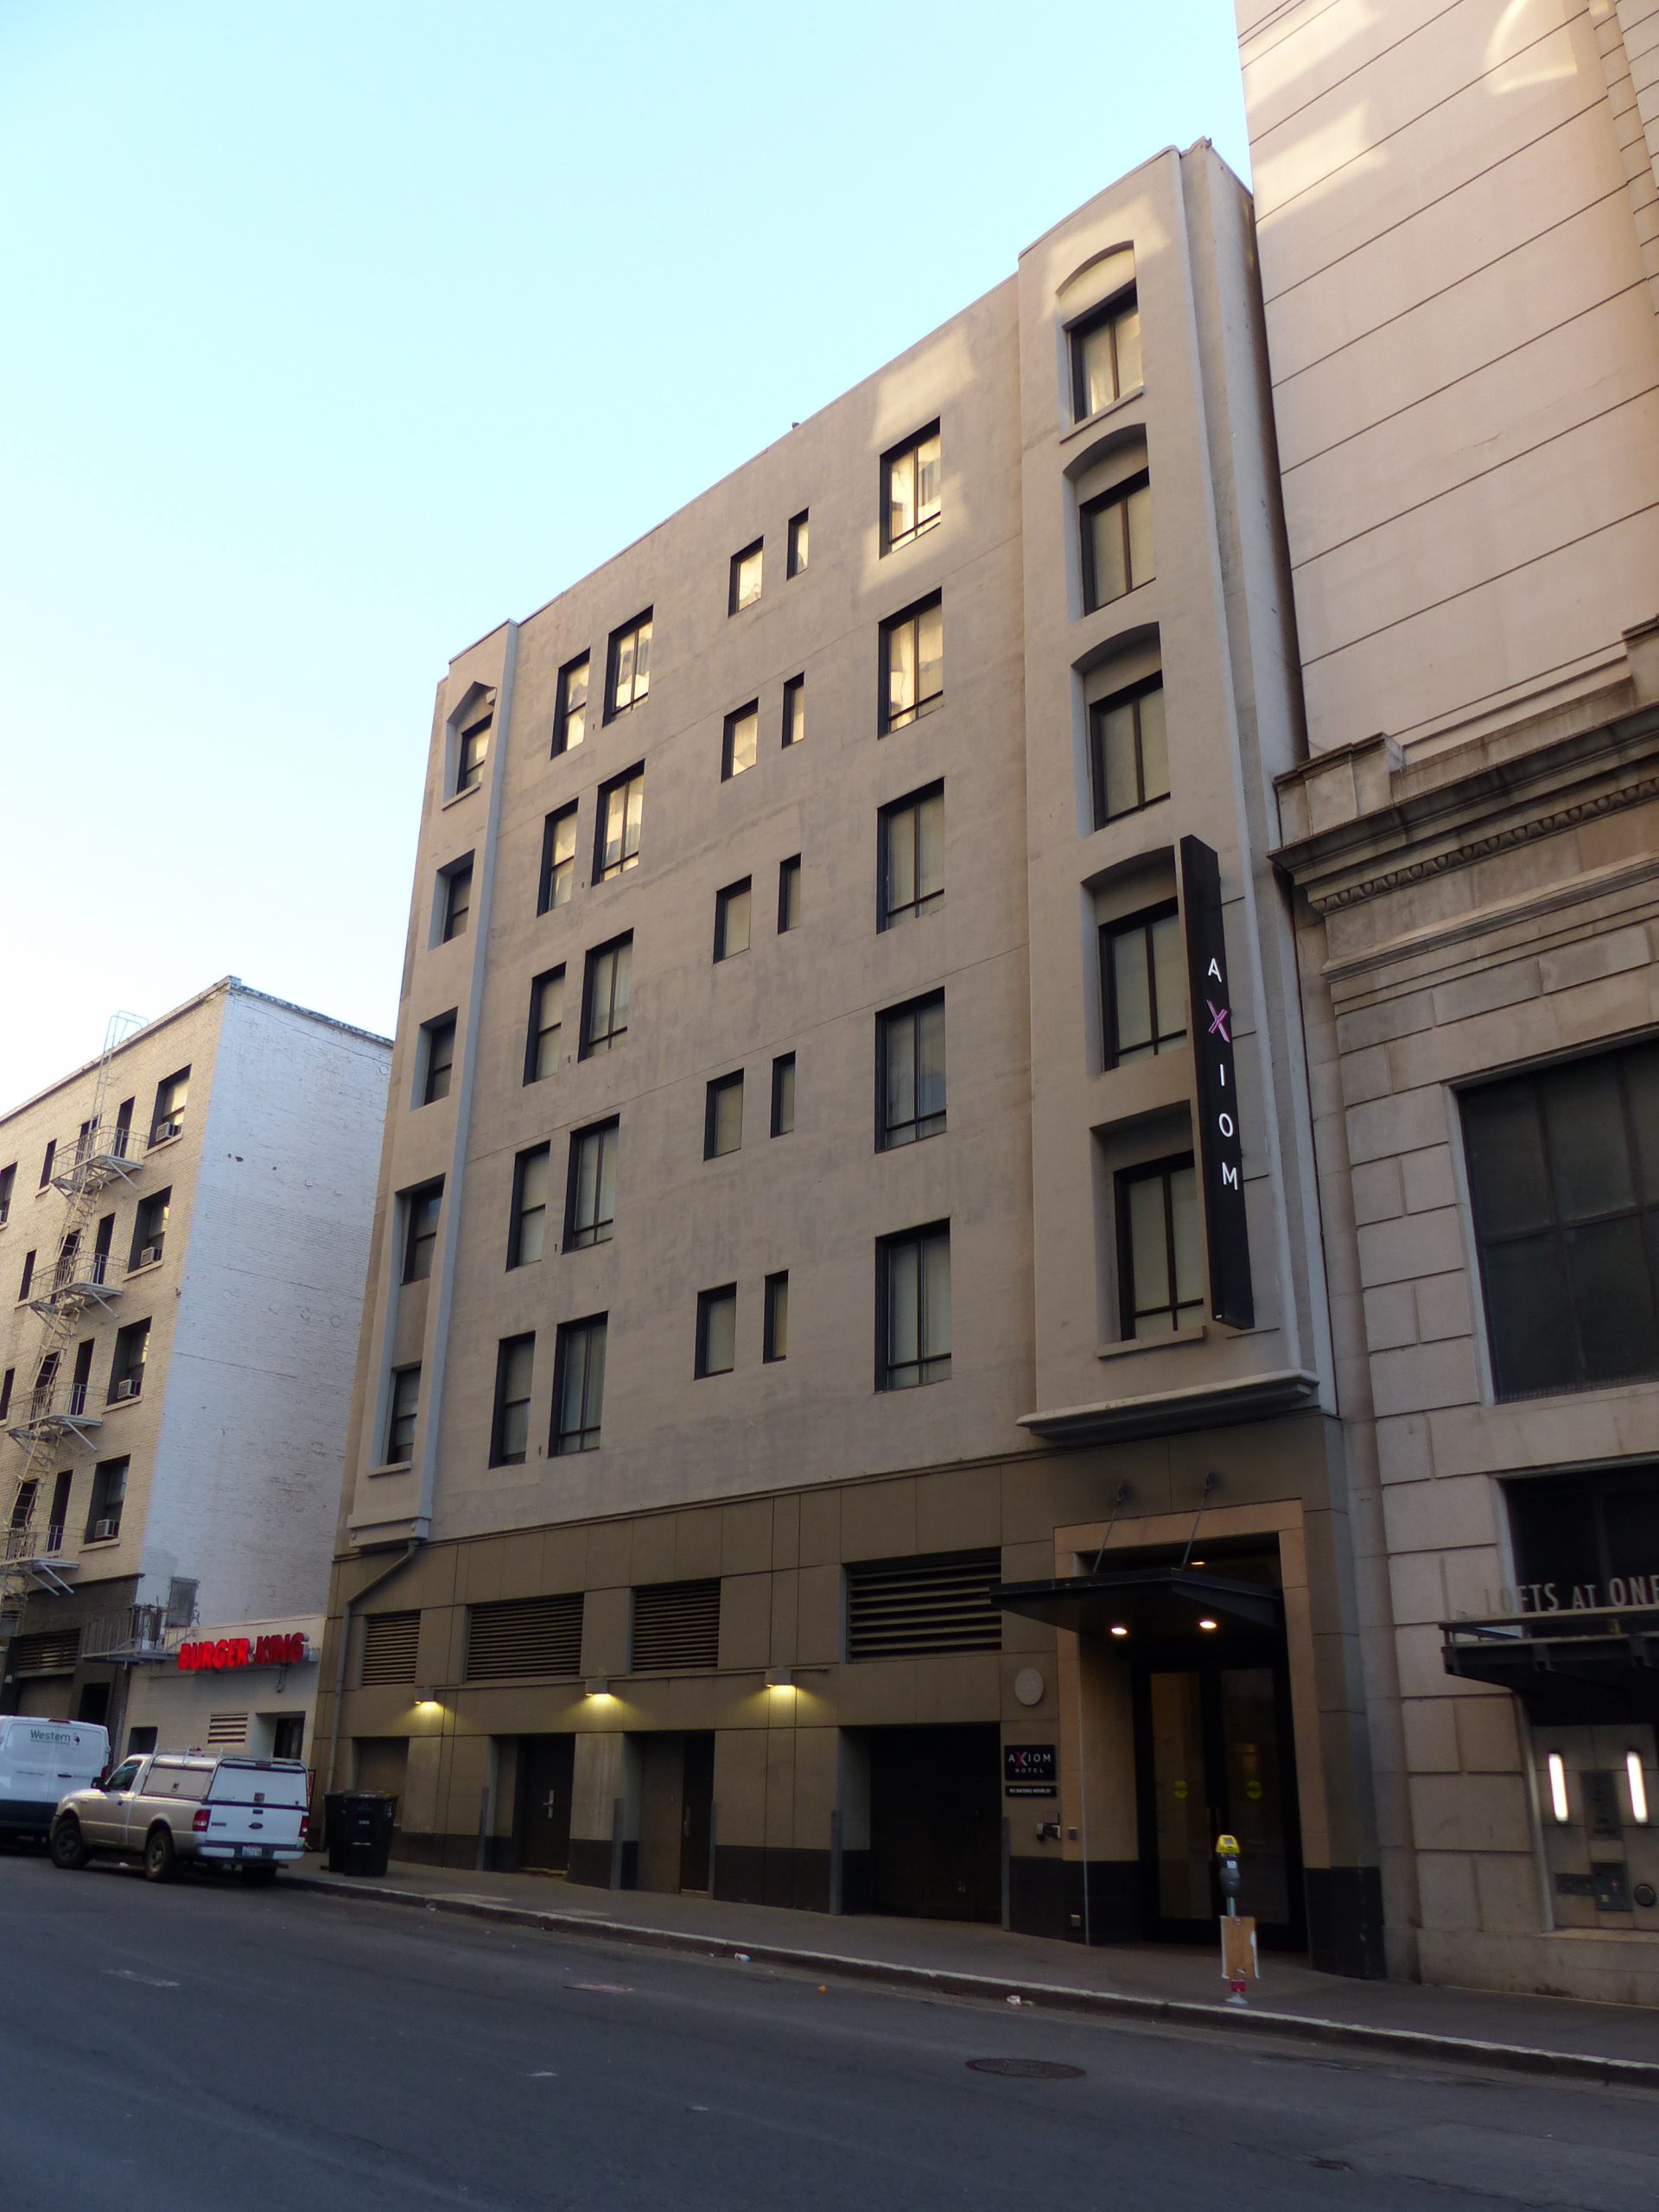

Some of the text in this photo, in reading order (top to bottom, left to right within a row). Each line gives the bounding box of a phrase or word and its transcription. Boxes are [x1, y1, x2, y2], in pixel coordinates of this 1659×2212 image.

[1206, 957, 1238, 1191] AXIOM
[1572, 1584, 1596, 1608] AT
[179, 1632, 308, 1670] BURGER KING
[30, 1729, 71, 1741] Western
[1007, 1751, 1051, 1766] AXIOM
